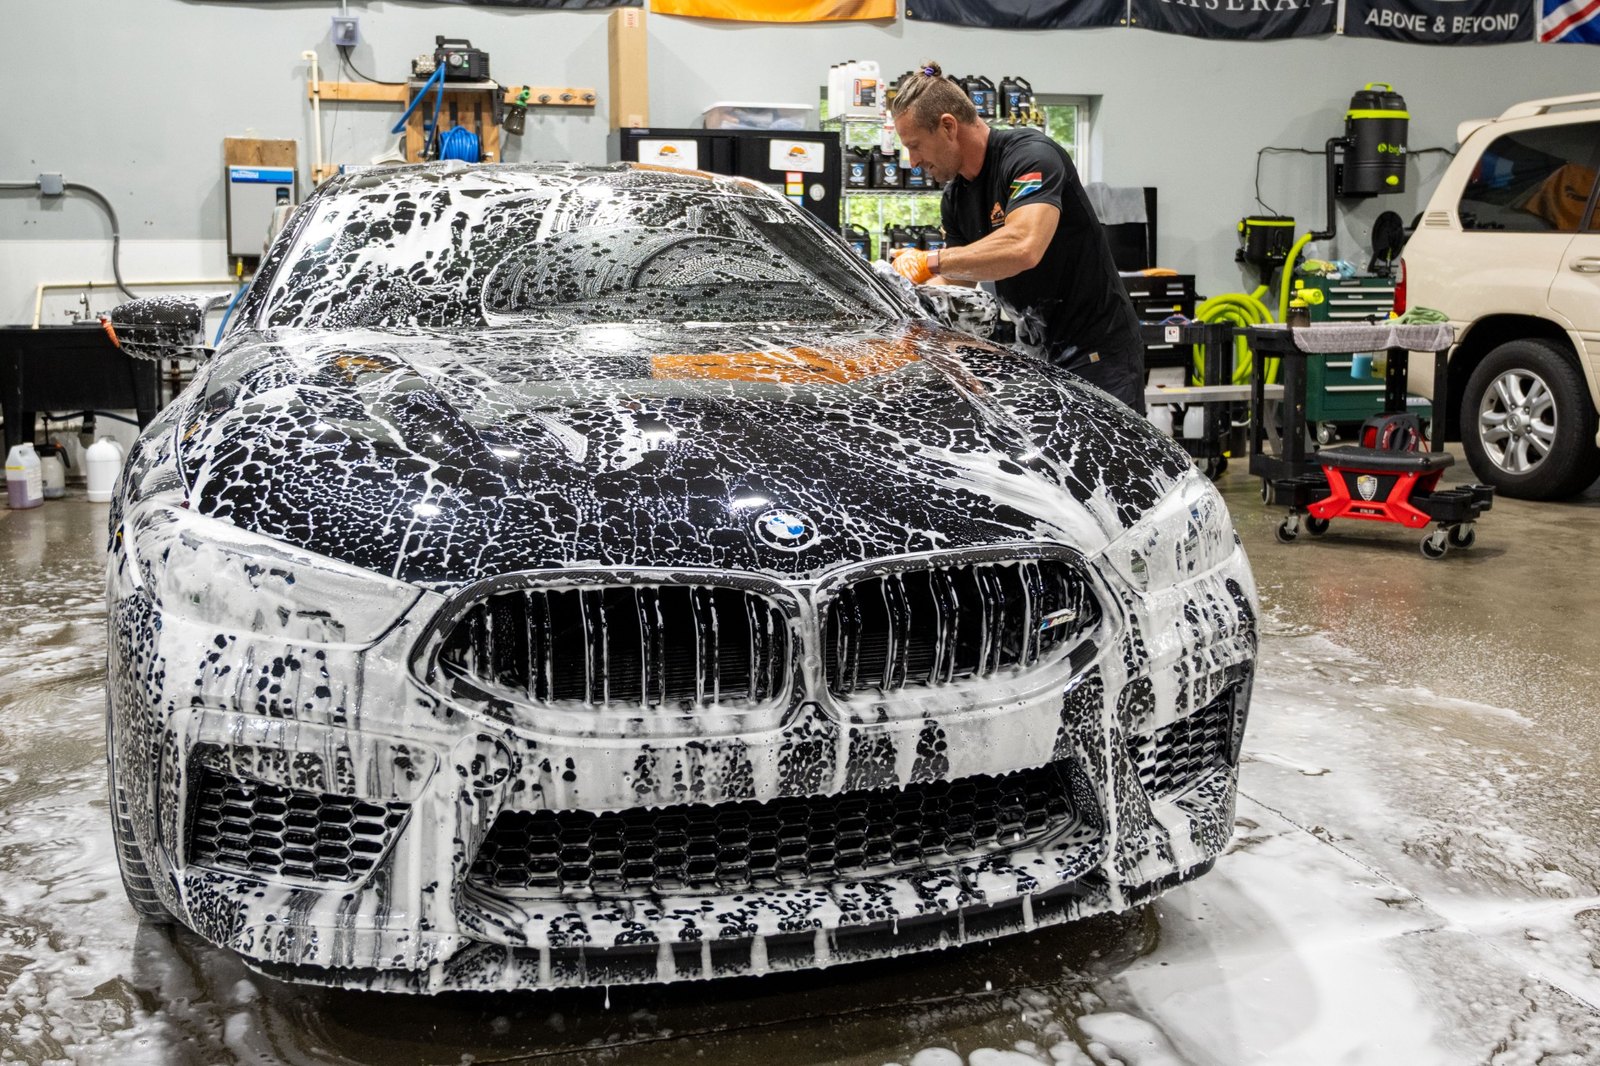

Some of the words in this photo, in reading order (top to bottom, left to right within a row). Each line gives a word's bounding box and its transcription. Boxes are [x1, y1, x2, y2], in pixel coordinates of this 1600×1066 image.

[1161, 0, 1334, 11] ASERA
[1365, 8, 1428, 32] ABOVE
[1432, 16, 1446, 33] &
[1452, 13, 1520, 34] BEYOND
